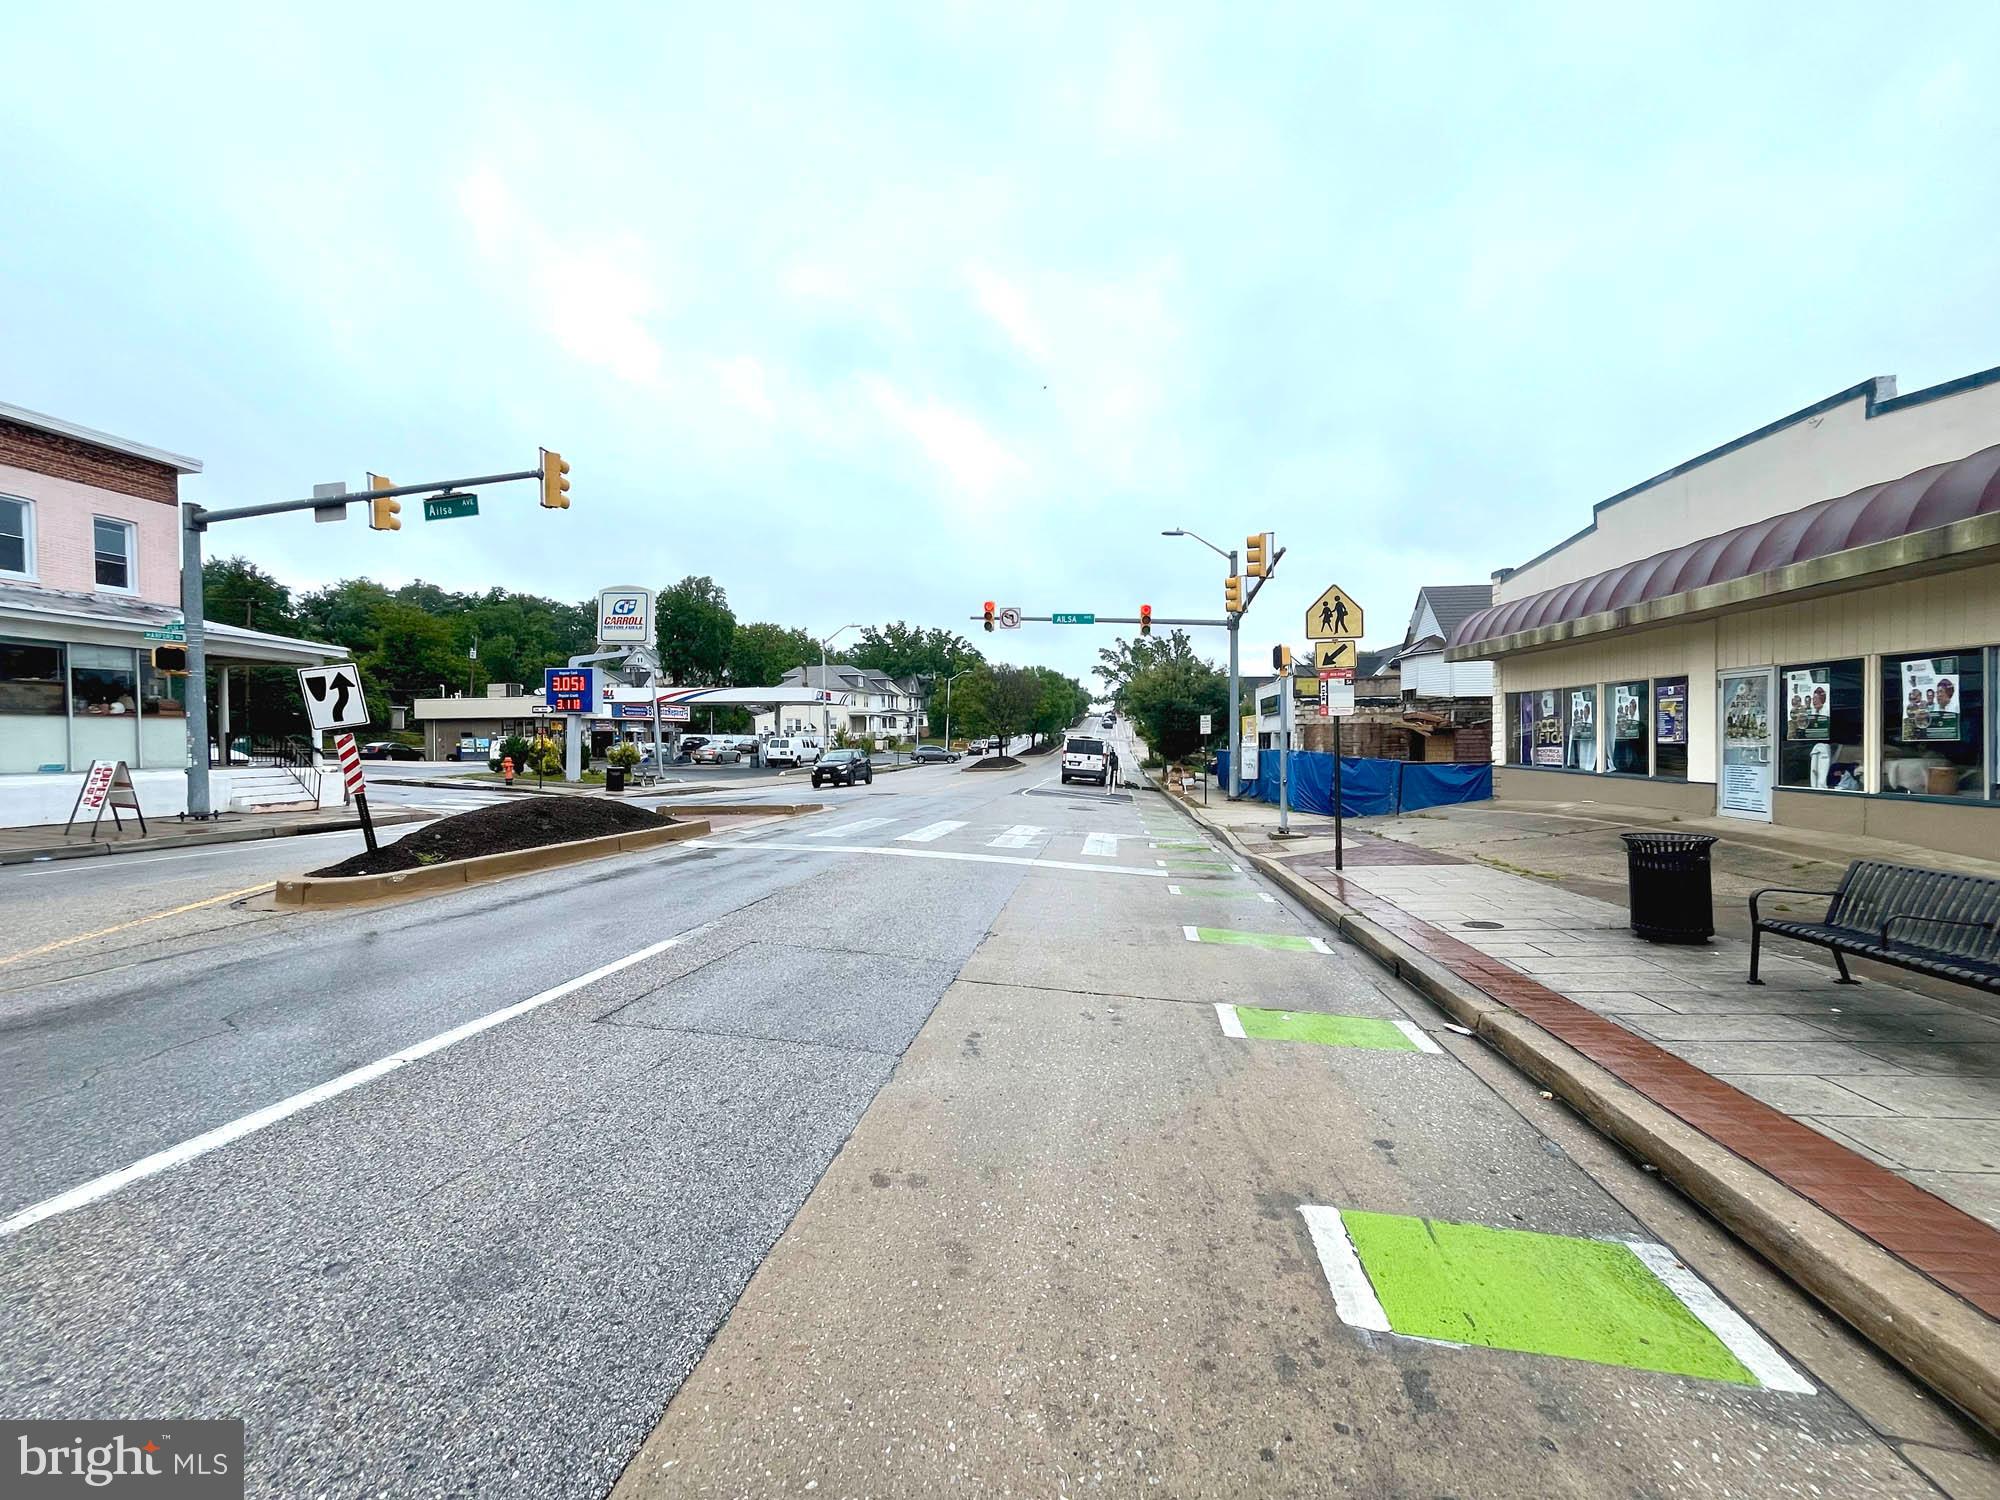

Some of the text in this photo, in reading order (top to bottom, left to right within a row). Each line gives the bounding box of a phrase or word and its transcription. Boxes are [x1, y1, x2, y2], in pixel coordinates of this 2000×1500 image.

[429, 503, 453, 517] Ailsa
[604, 616, 644, 626] CARROLL
[90, 767, 113, 808] OPEN
